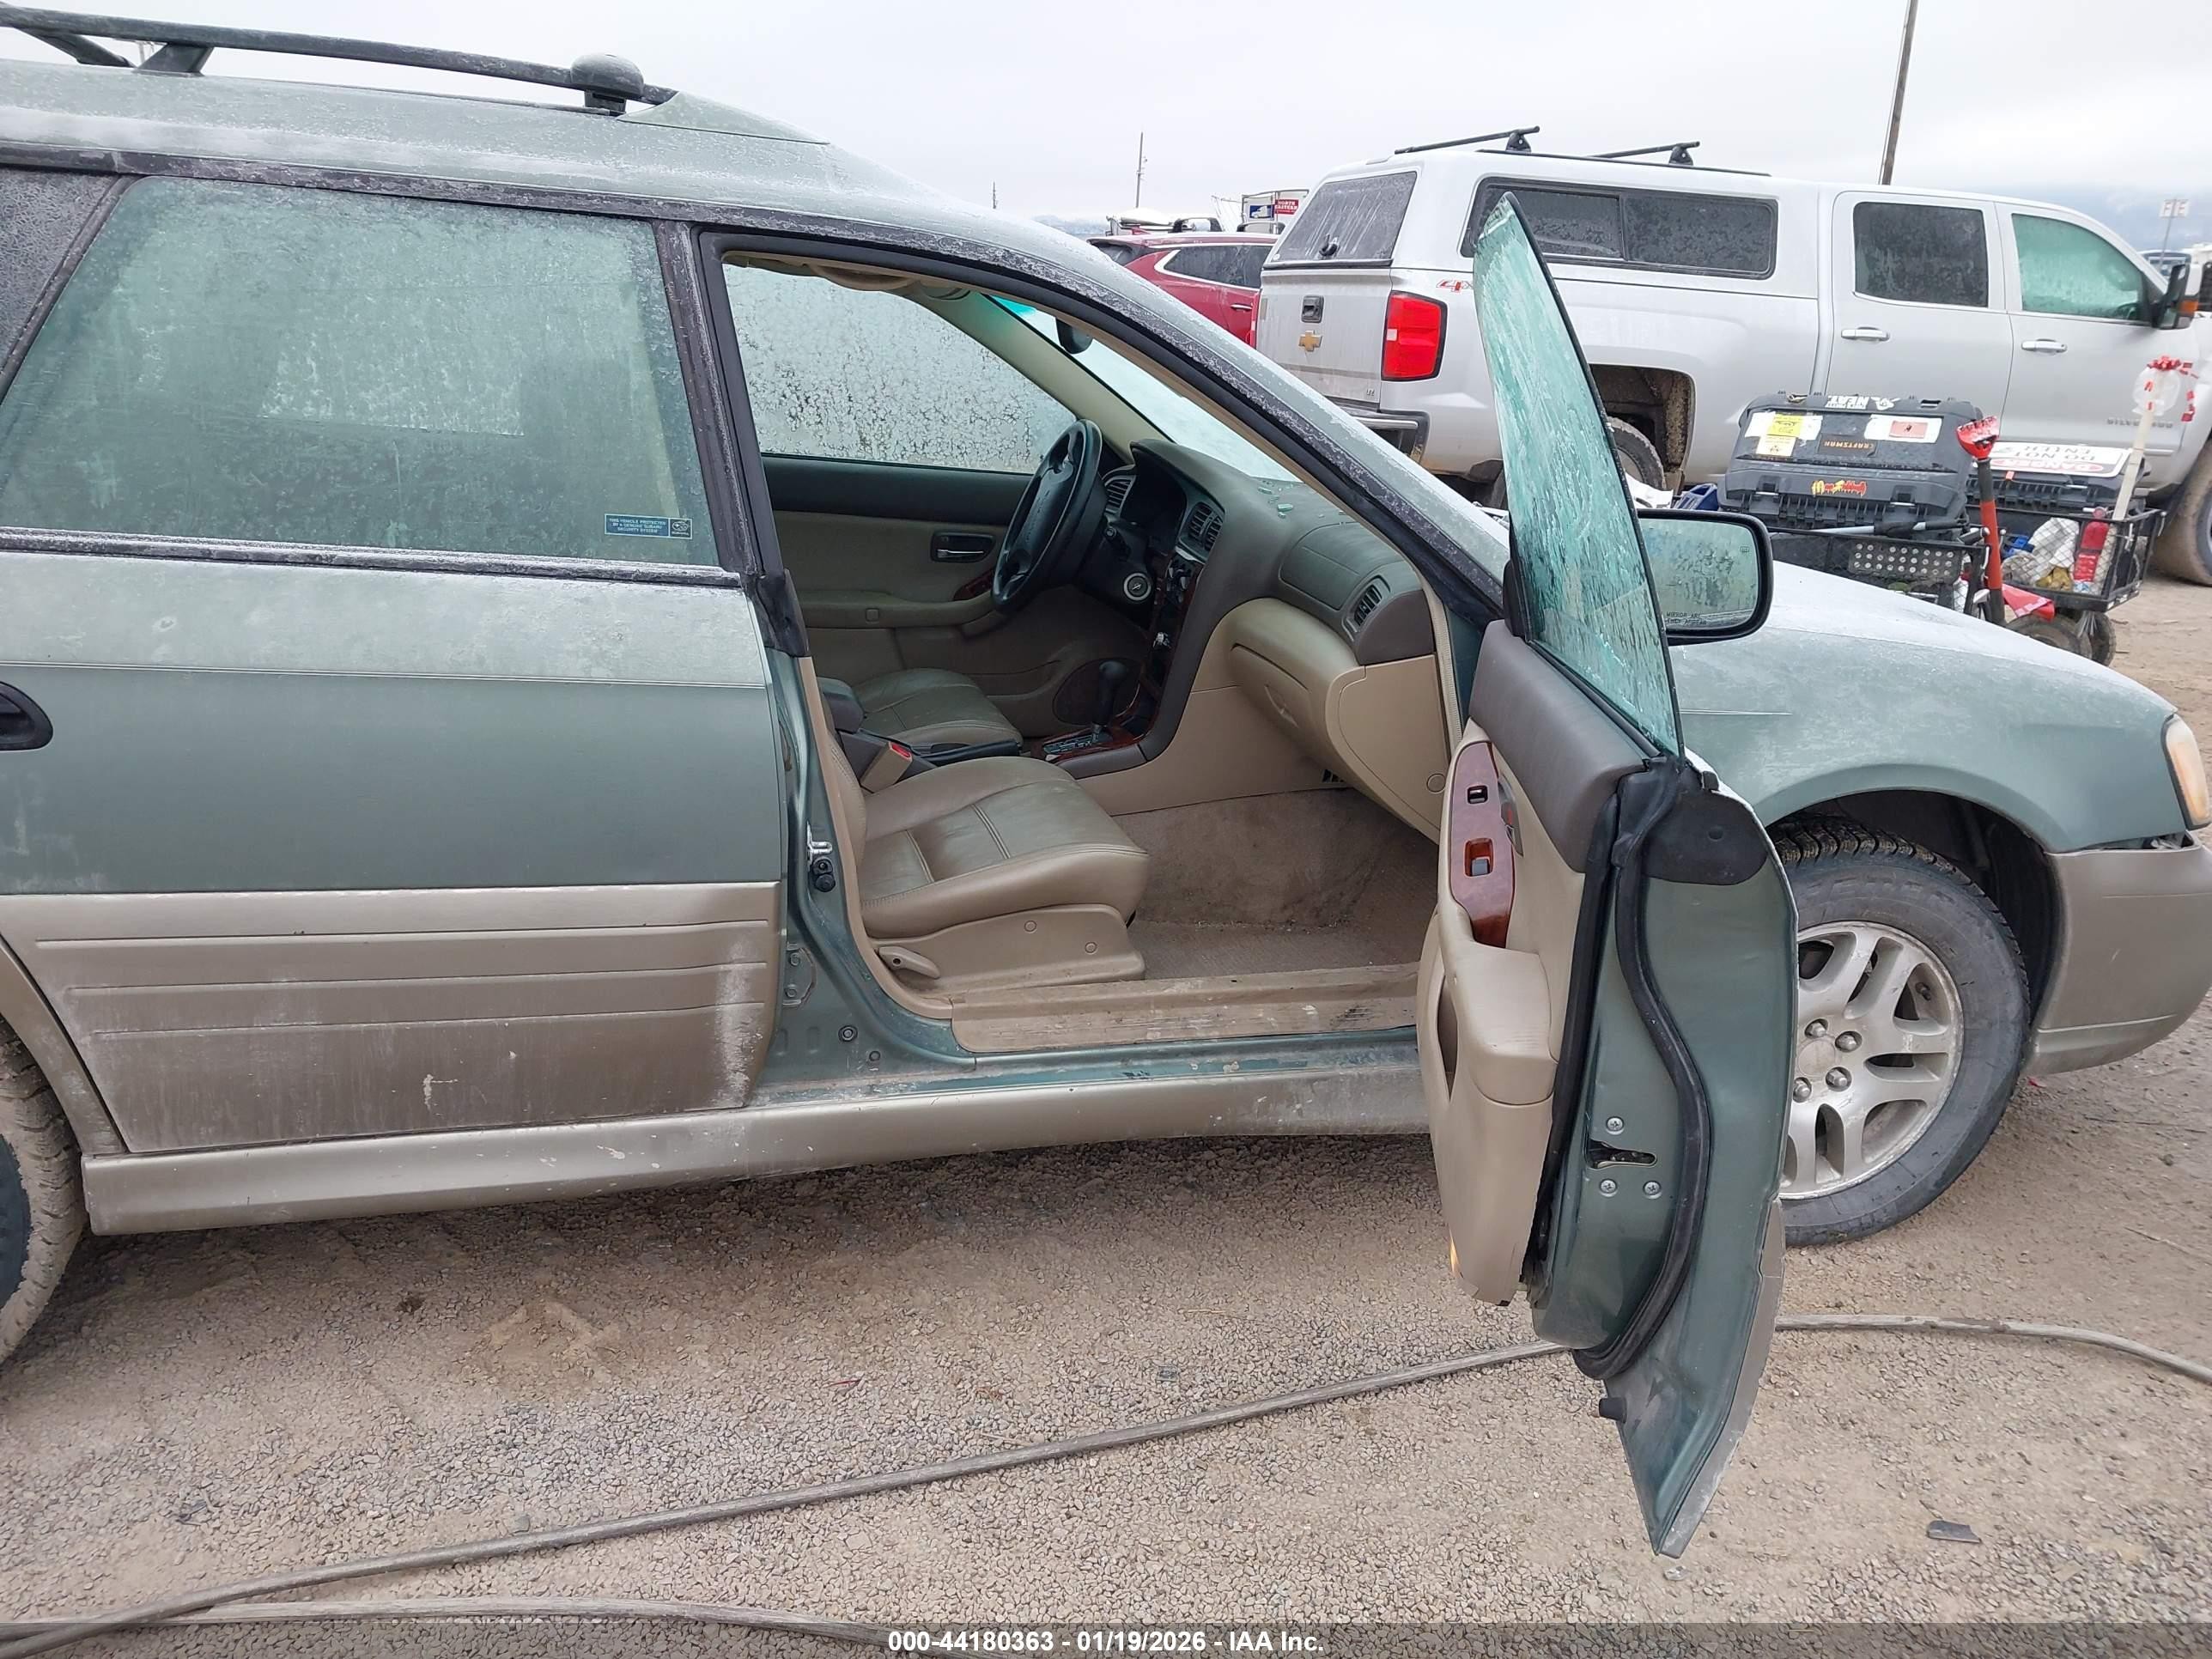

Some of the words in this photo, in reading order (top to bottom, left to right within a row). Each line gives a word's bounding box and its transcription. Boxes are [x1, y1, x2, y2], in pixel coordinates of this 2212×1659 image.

[2106, 418, 2173, 428] SILVEADO
[1823, 441, 1875, 450] CRAFTSMAN
[2014, 451, 2056, 459] NOT
[2008, 459, 2090, 471] DANGER
